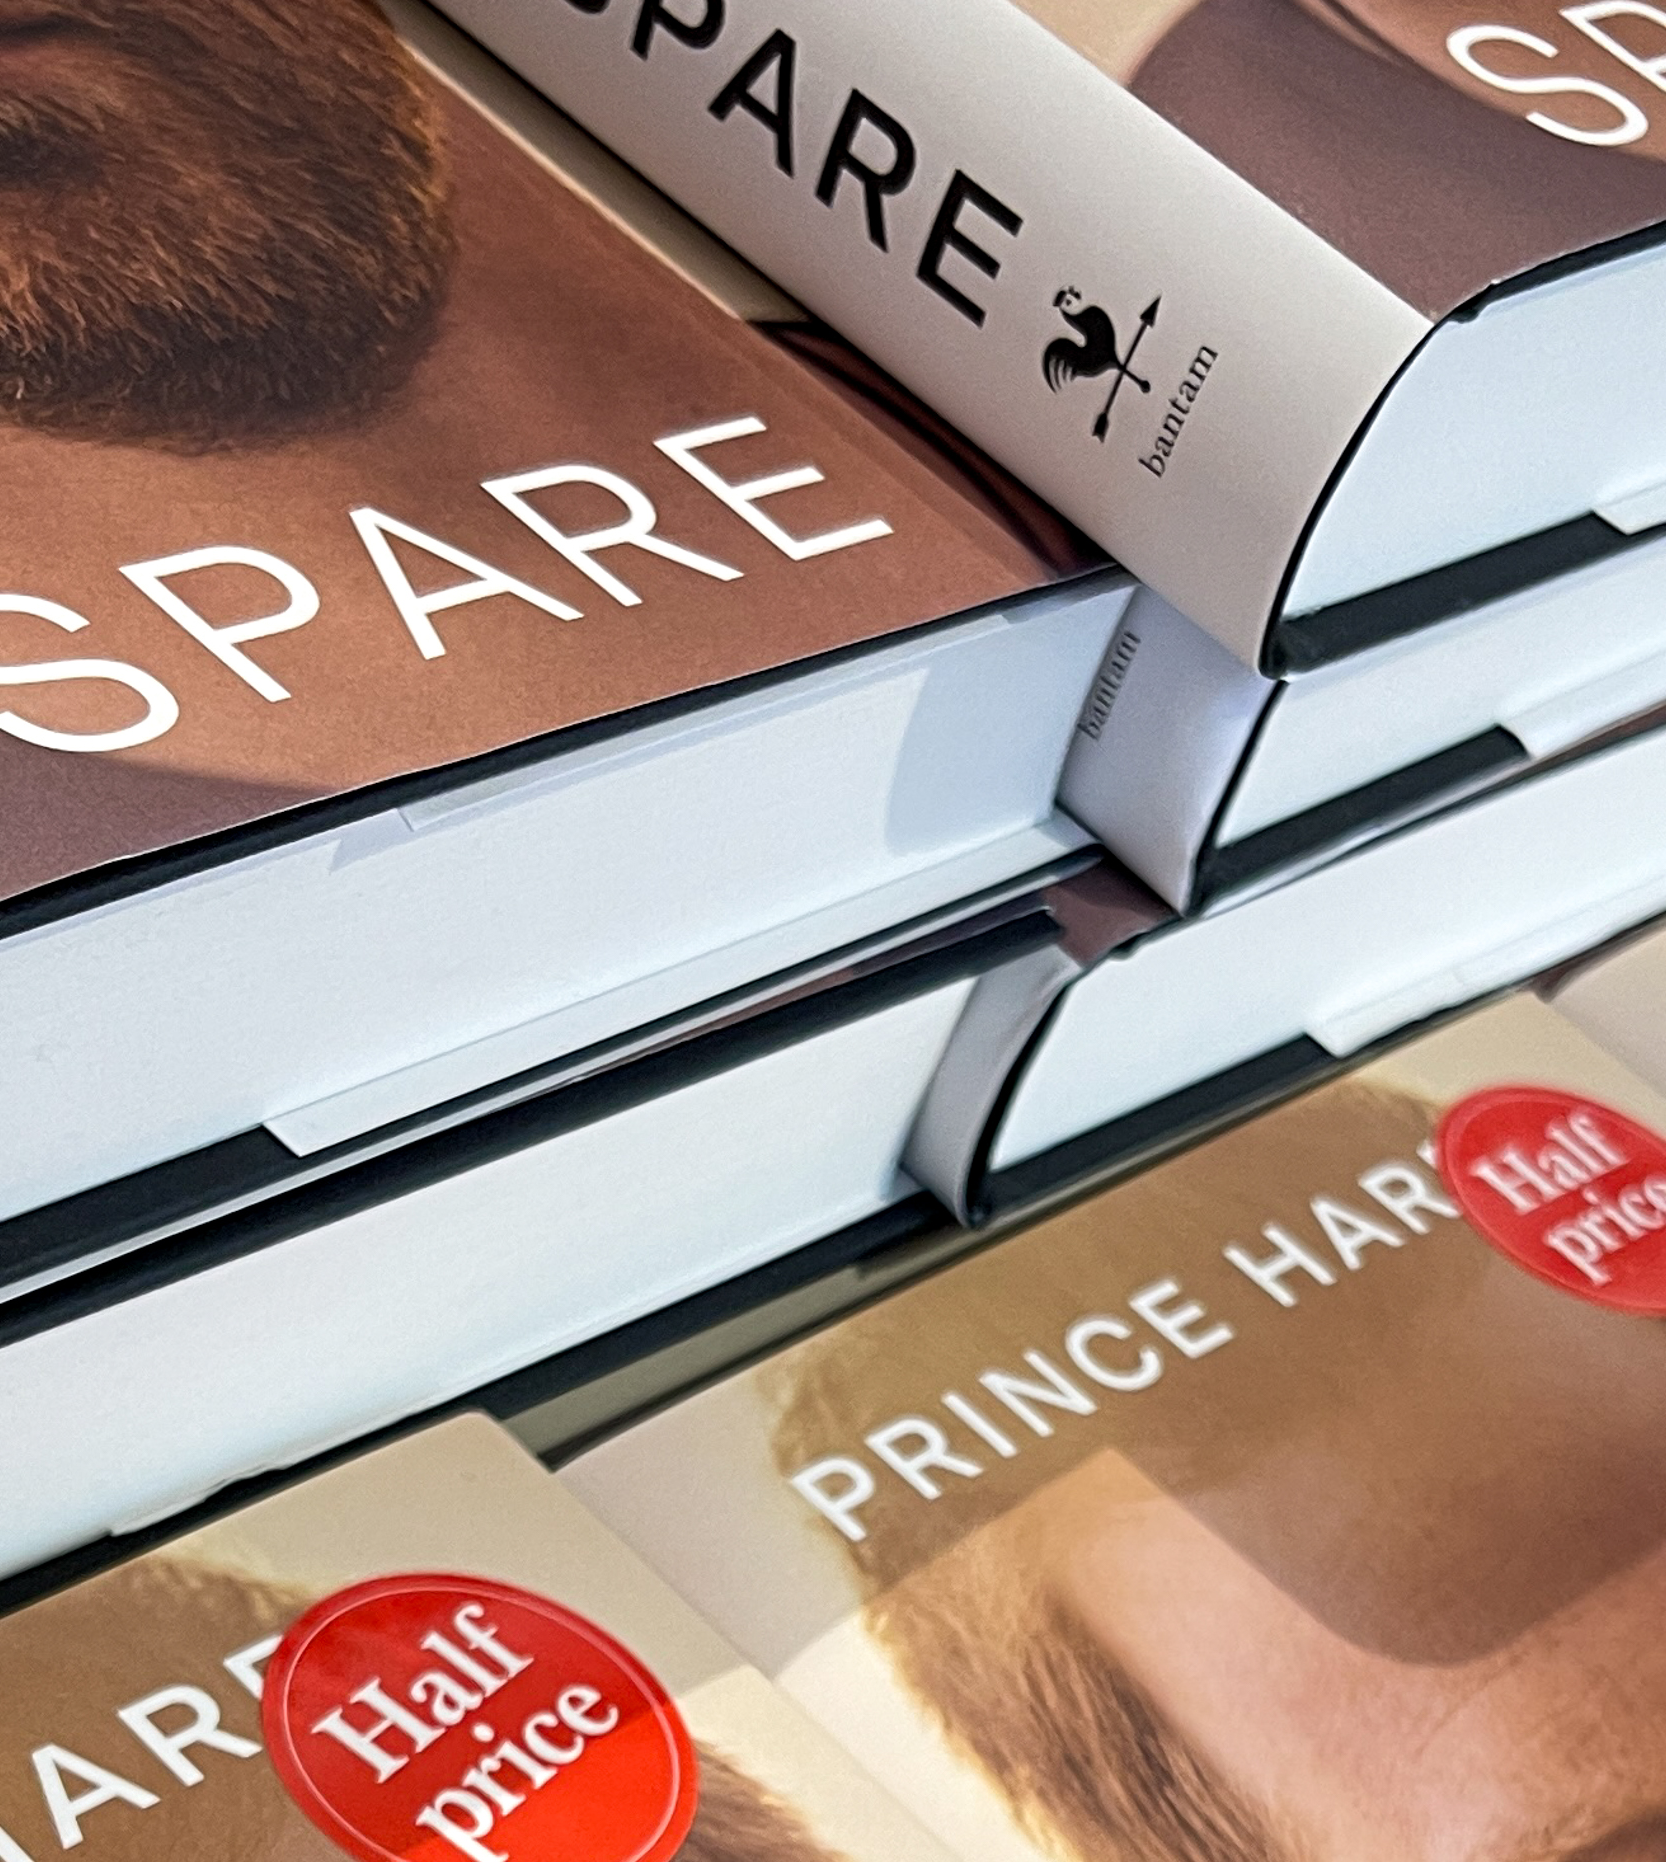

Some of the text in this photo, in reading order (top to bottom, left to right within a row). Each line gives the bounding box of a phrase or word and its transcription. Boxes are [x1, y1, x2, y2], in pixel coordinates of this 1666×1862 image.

[569, 0, 1024, 327] PARE
[1137, 342, 1218, 478] bantam
[1076, 630, 1141, 742] bantam
[1467, 1109, 1631, 1216] Half
[789, 1138, 1463, 1544] PRINCE HAR
[310, 1602, 534, 1784] Half
